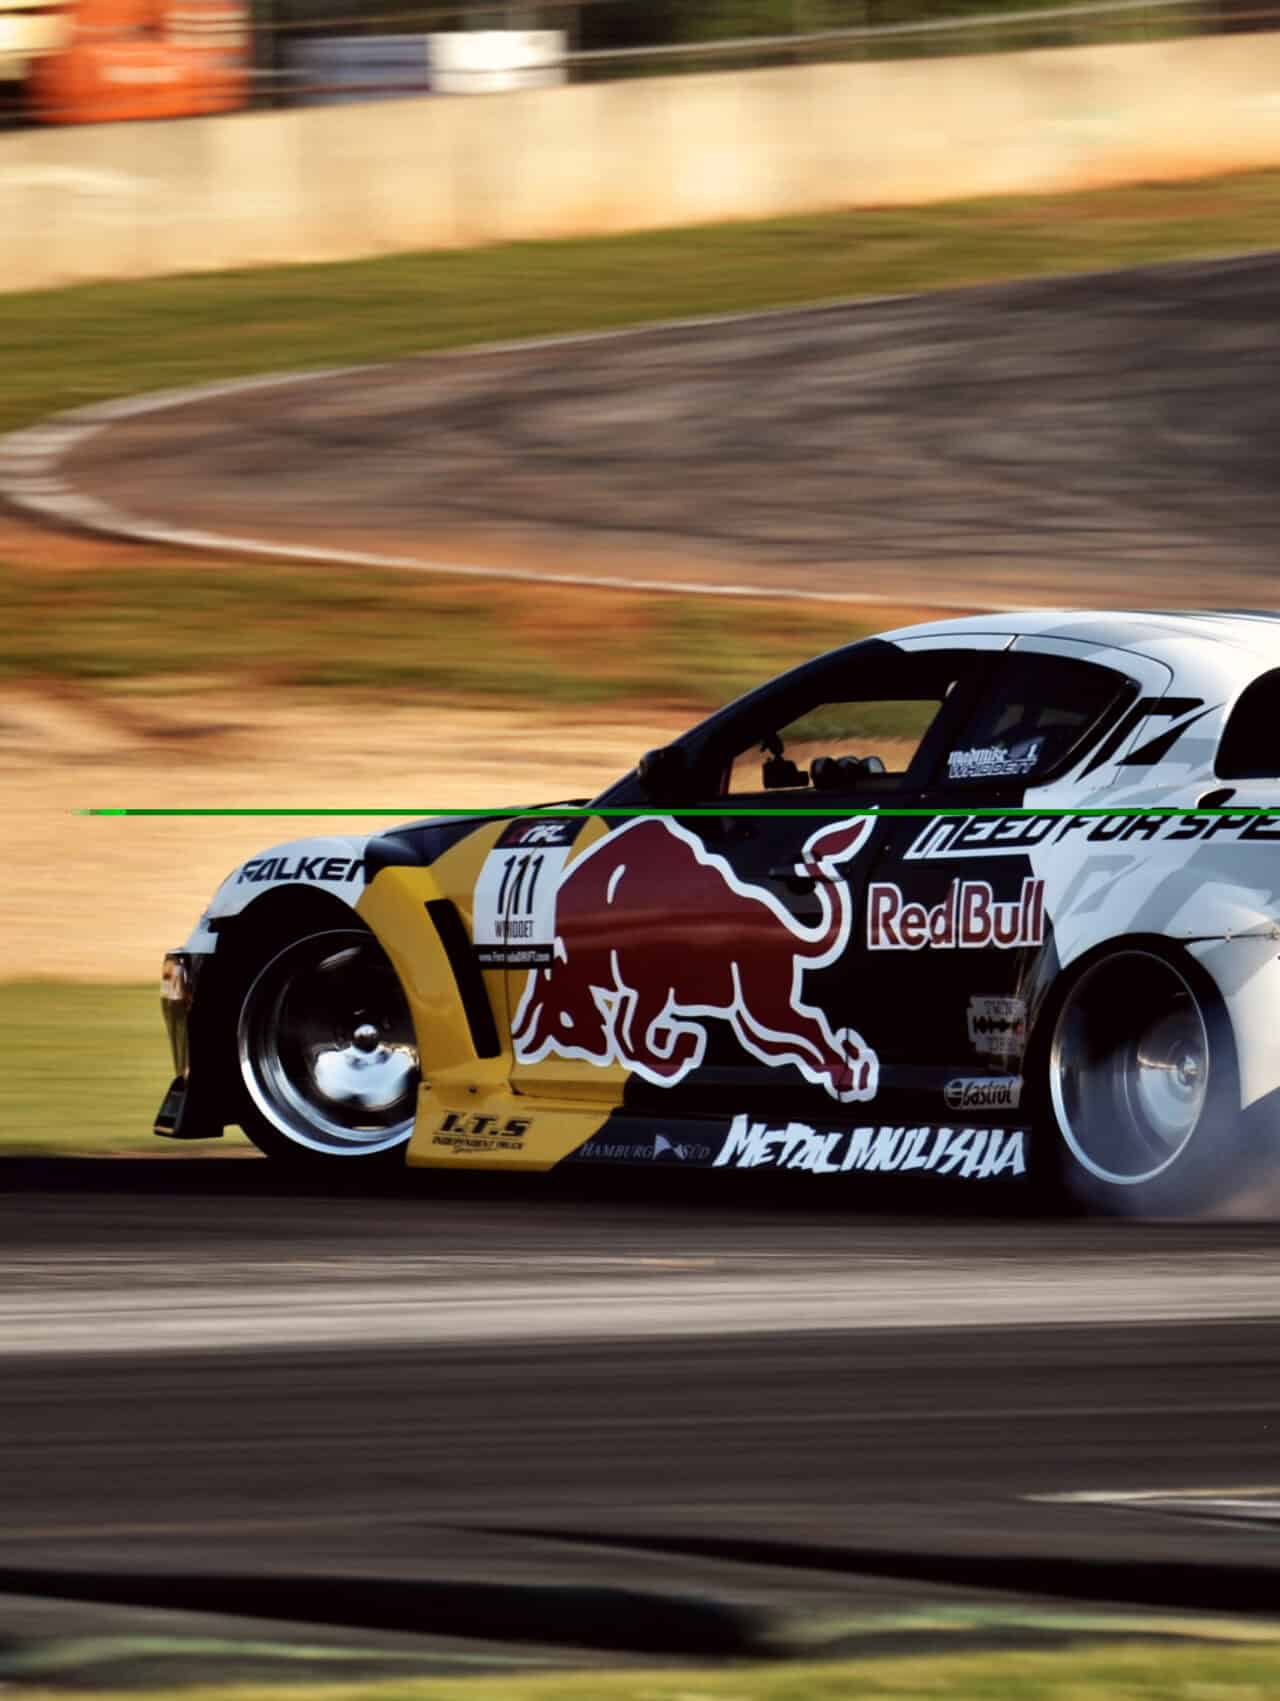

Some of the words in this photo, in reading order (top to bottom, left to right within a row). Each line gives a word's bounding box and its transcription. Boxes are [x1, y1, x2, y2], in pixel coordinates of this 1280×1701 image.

[905, 811, 1058, 859] NEED
[1053, 807, 1182, 842] FOR
[497, 855, 545, 915] 111
[962, 1080, 1014, 1105] Castrol
[711, 1113, 845, 1174] METAL
[840, 1126, 1026, 1179] MULISHA
